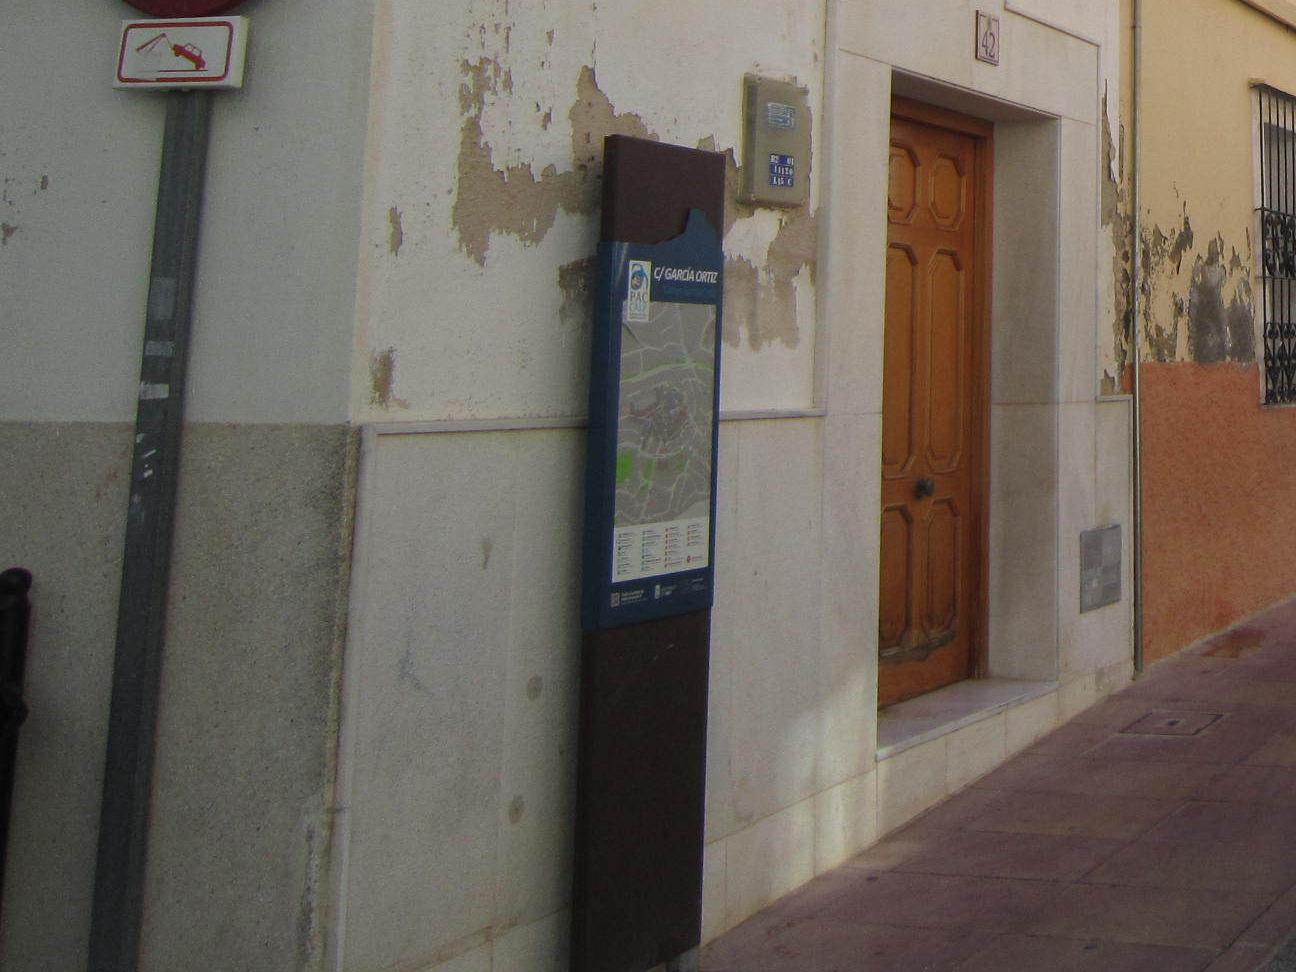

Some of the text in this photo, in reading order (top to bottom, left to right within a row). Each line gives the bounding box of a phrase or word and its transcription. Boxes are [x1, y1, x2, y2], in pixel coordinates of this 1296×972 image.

[982, 31, 995, 57] 42
[654, 266, 718, 283] C/ GARCÍA ORTIZ
